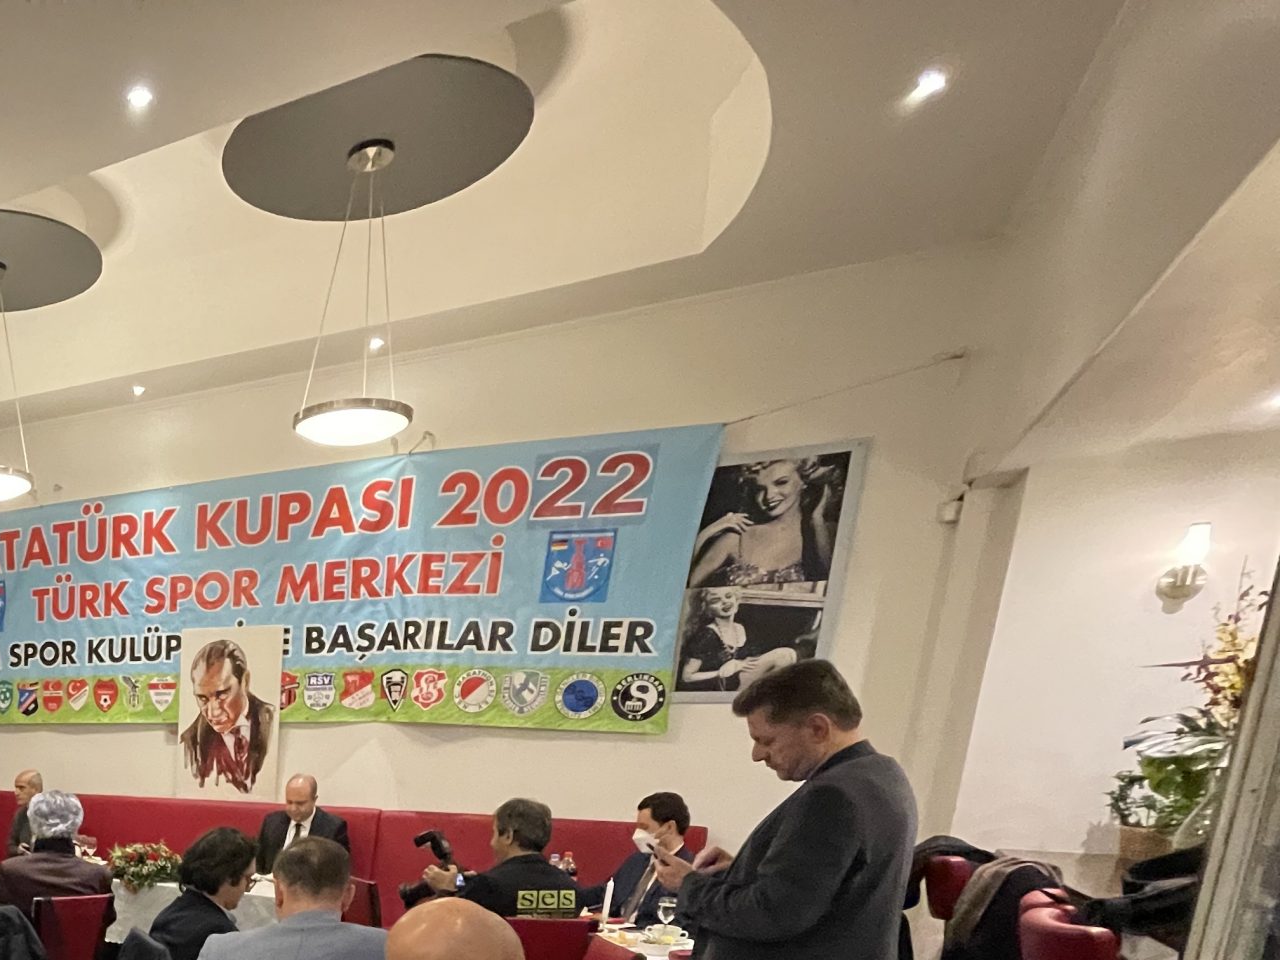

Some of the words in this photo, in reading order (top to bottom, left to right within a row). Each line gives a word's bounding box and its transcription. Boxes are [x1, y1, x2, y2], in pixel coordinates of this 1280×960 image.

[195, 477, 415, 550] KUPASI
[433, 450, 651, 528] 2022
[31, 573, 129, 622] TÜRK
[143, 569, 260, 614] SPOR
[275, 533, 504, 605] MERKEZİ
[8, 639, 78, 668] SPOR
[304, 619, 515, 661] BAŞARILAR
[529, 607, 655, 654] DİLER
[309, 675, 331, 685] RSV
